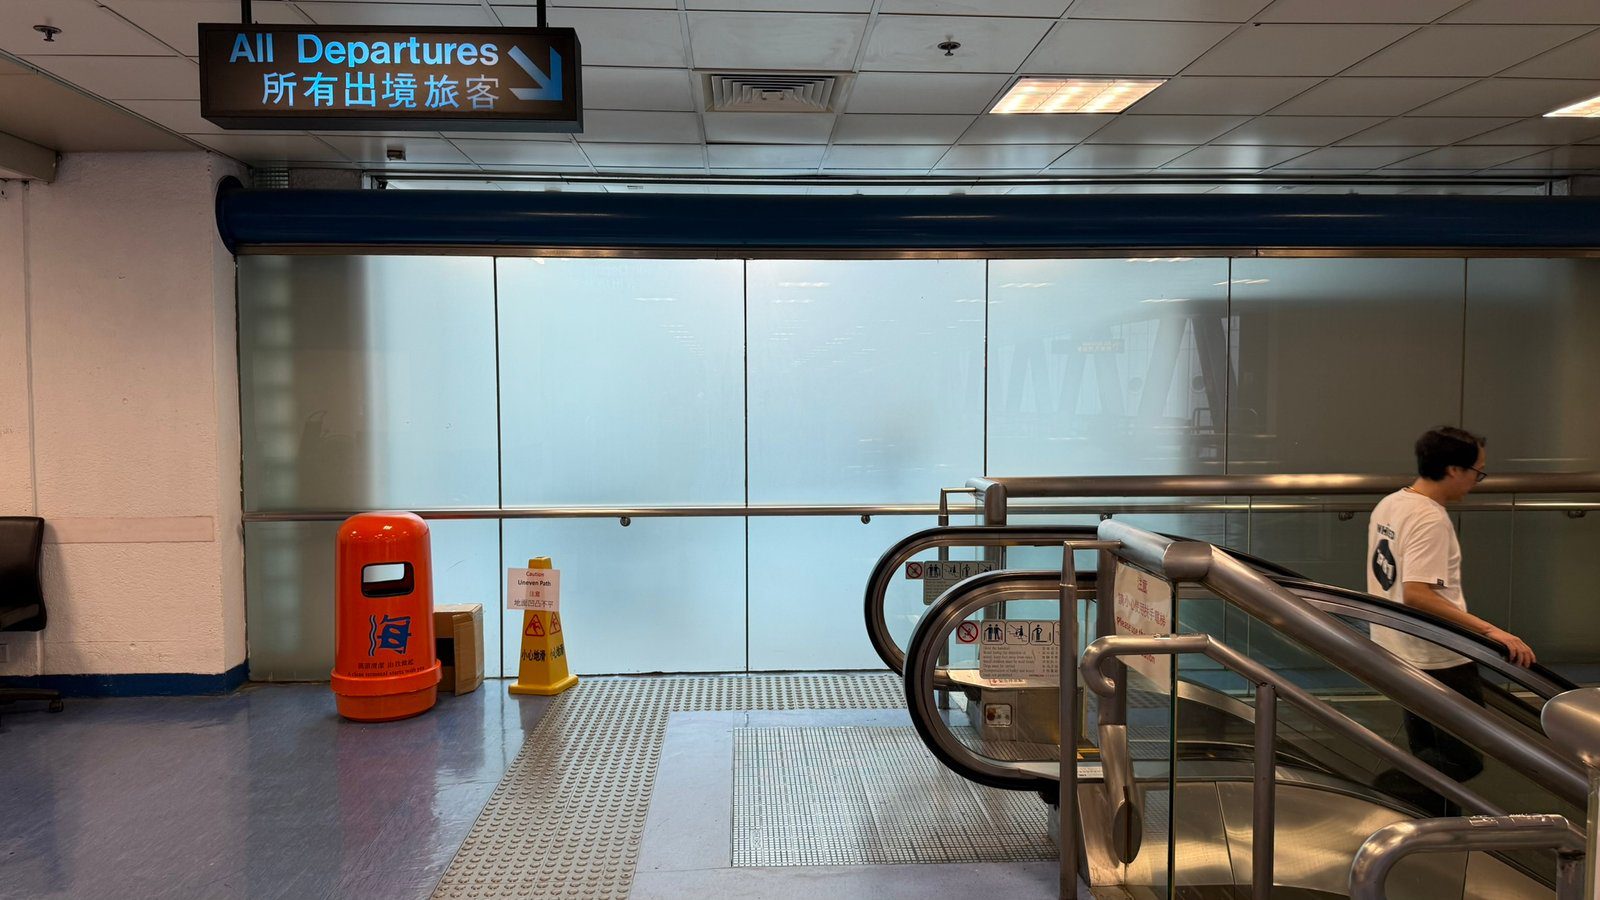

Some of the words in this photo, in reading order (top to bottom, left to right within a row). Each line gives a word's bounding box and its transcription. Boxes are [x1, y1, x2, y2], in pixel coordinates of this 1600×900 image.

[229, 33, 273, 63] All
[298, 33, 499, 67] Departures
[262, 72, 500, 109] 所有出境旅客
[521, 648, 546, 661] 小心地滑
